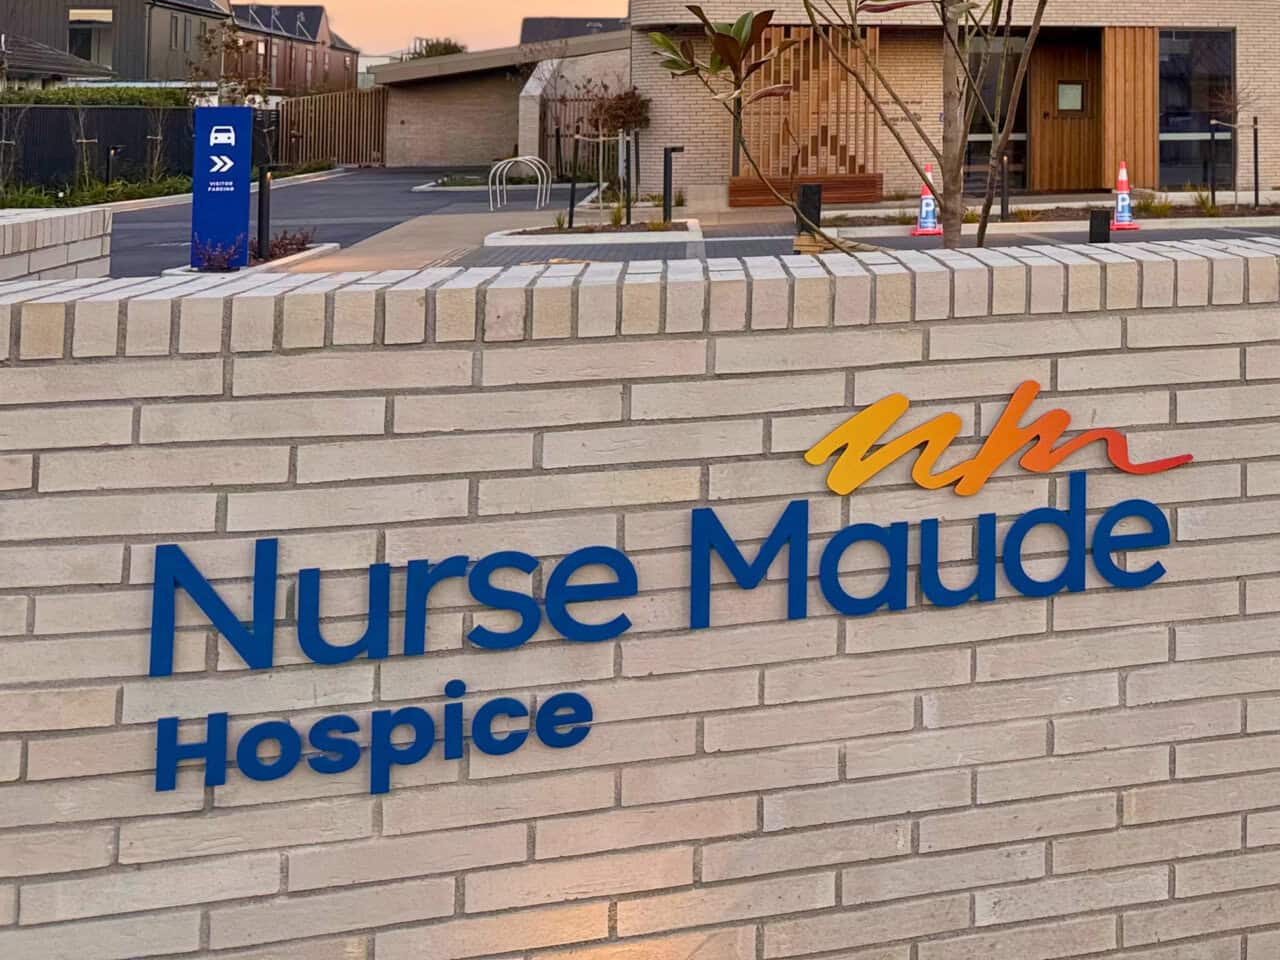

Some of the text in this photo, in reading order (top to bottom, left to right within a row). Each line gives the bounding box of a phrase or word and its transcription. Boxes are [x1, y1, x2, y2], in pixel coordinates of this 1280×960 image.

[921, 199, 935, 218] P
[1118, 194, 1130, 212] P
[149, 471, 1171, 678] Nurse Maude
[155, 678, 593, 795] Hospice
